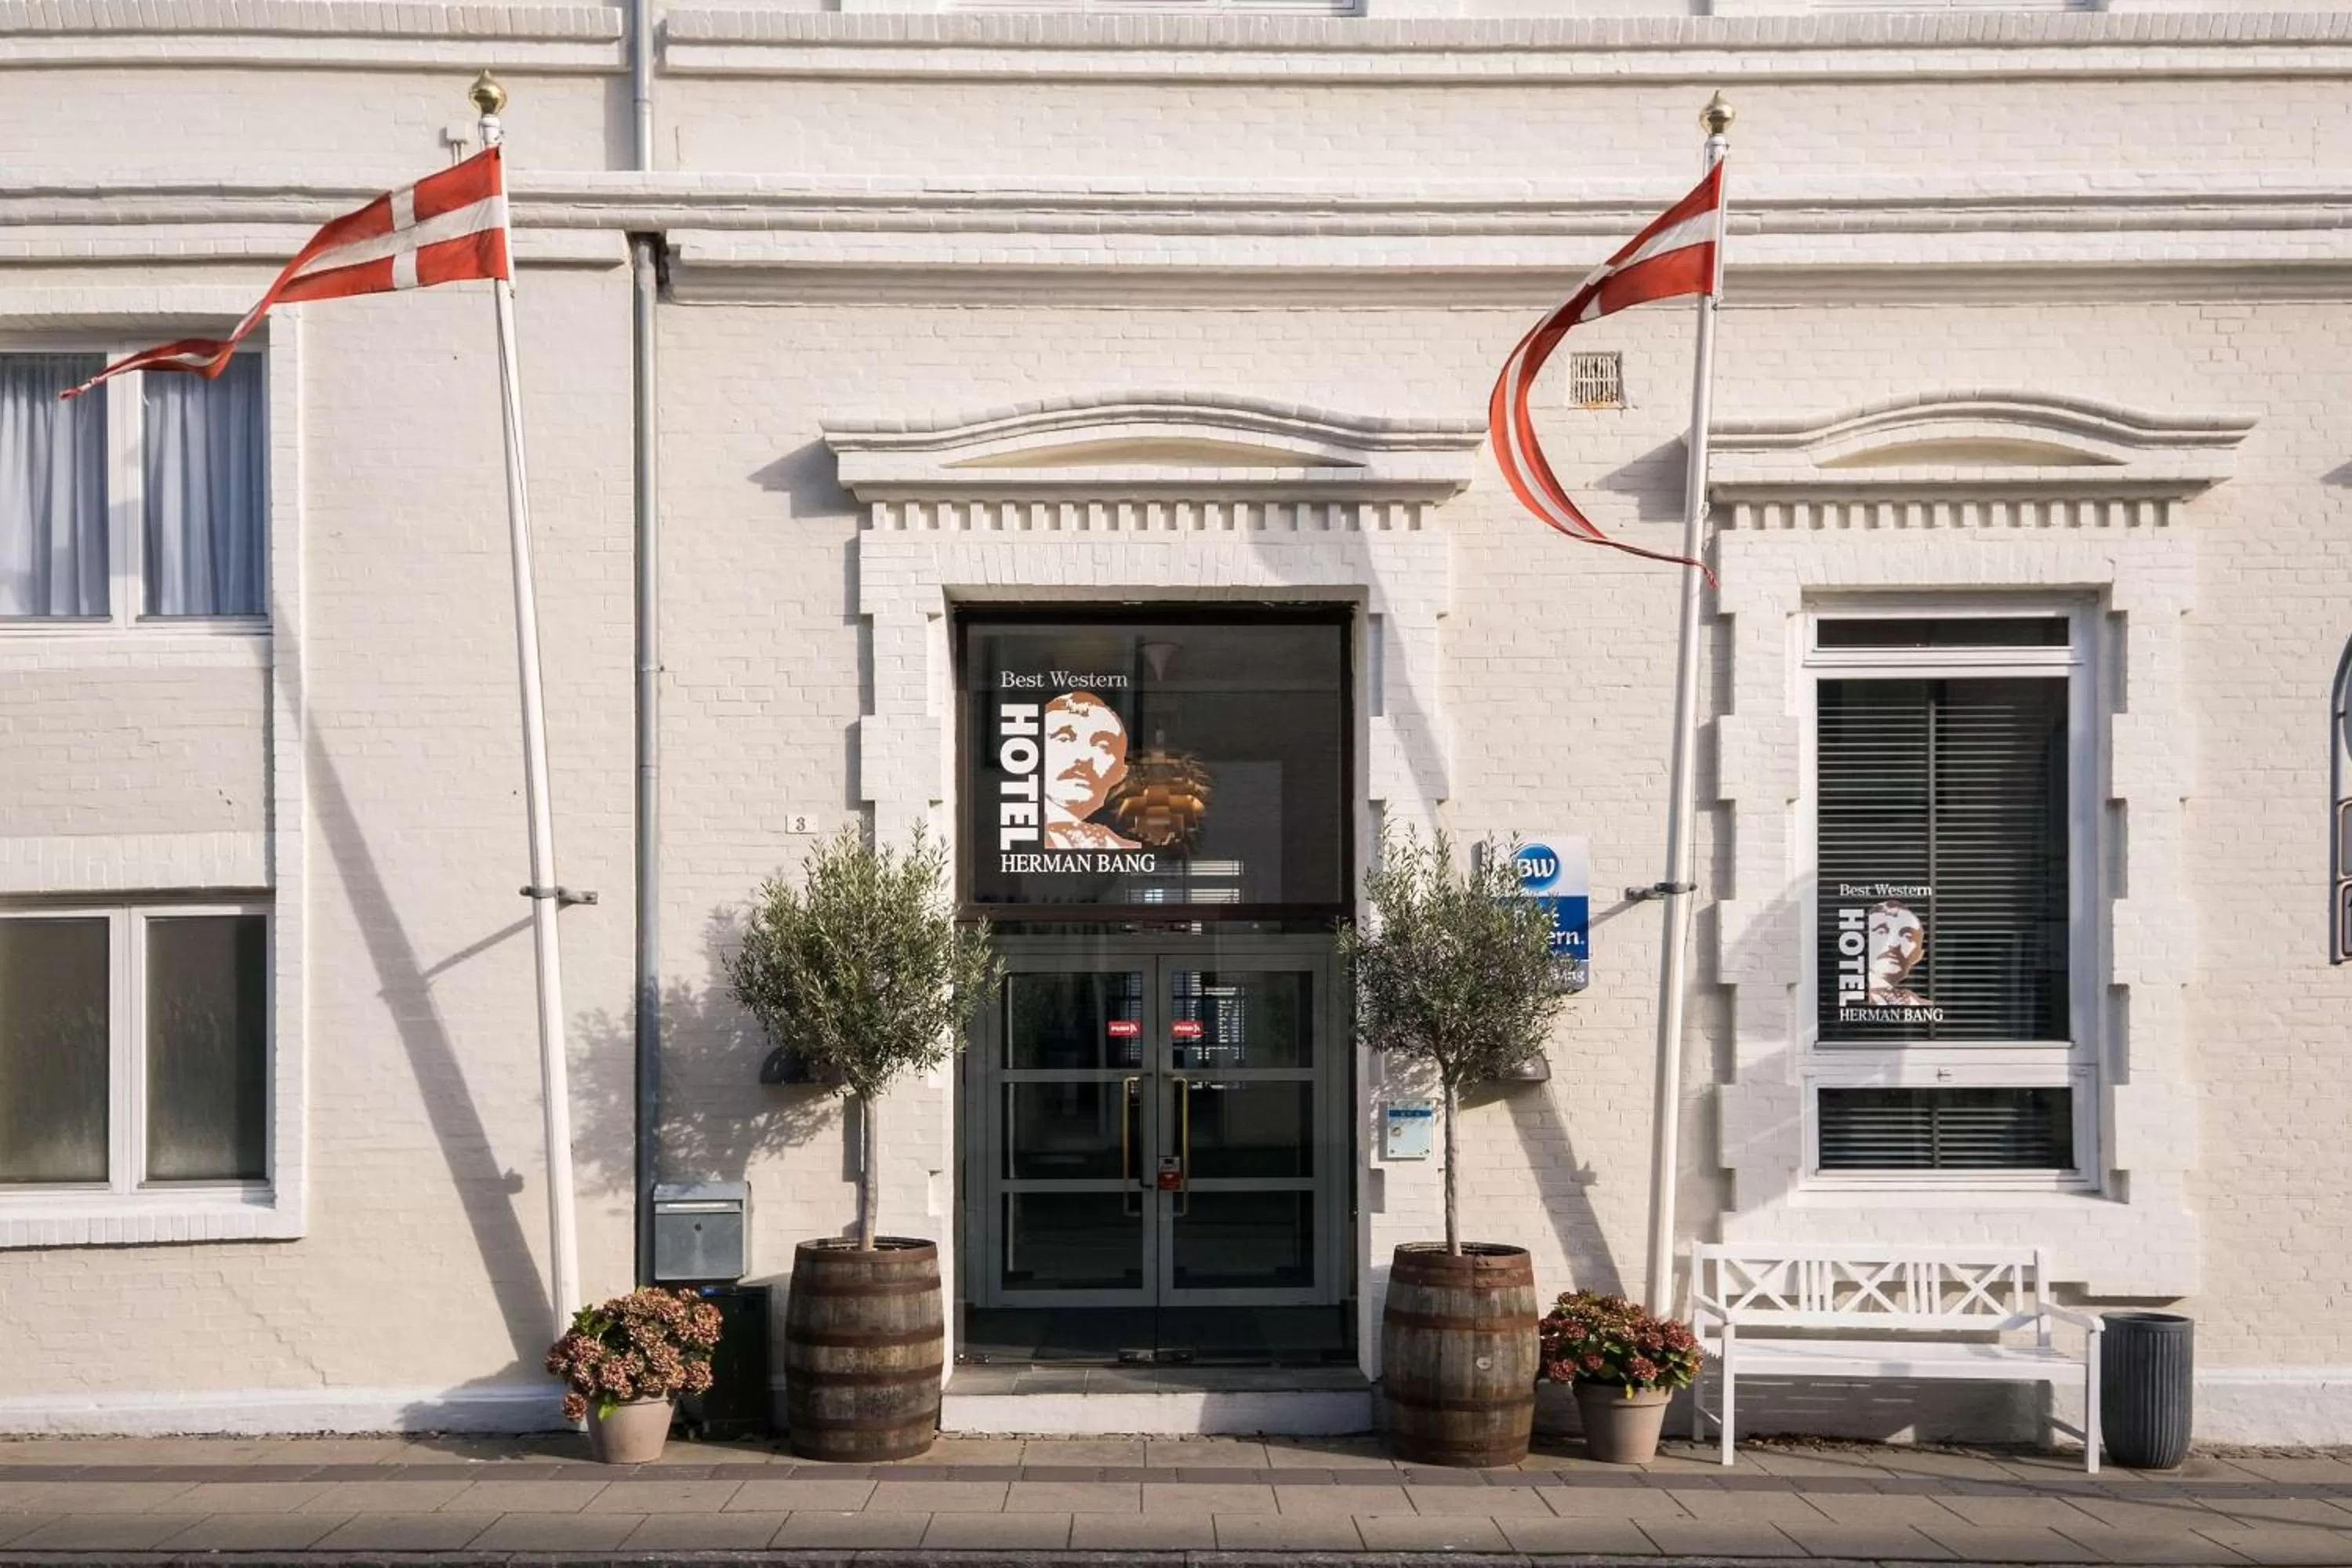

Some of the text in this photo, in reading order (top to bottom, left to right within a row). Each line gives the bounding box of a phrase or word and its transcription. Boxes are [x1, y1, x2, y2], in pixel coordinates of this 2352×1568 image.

[1000, 670, 1128, 688] Best Western
[1000, 703, 1040, 851] HOTEL
[796, 816, 806, 832] 3
[1000, 853, 1156, 873] HERMAN BANG
[1517, 858, 1555, 878] BW
[1839, 884, 1933, 896] Best Western
[1838, 909, 1865, 1007] HOTEL
[1839, 1007, 1944, 1022] HERMAN BANG
